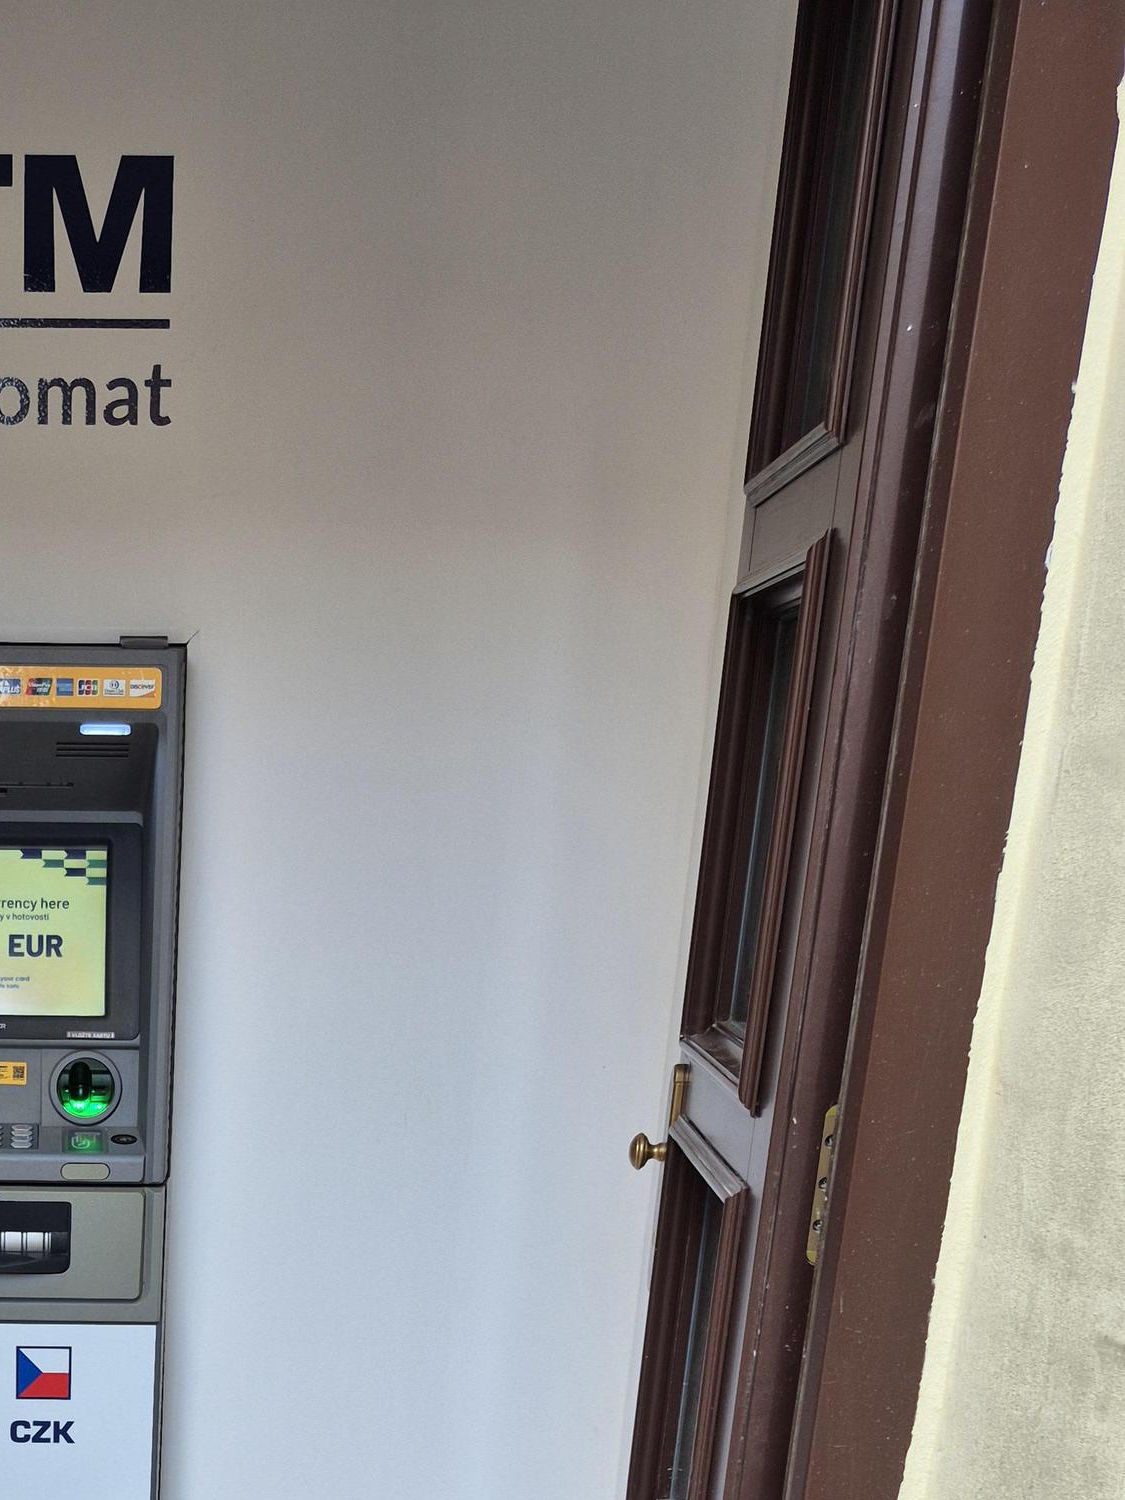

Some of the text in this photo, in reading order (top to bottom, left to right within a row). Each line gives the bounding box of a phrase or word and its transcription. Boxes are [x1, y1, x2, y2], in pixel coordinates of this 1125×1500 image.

[40, 898, 70, 910] here
[8, 934, 63, 958] EUR
[10, 1420, 75, 1444] CZK
